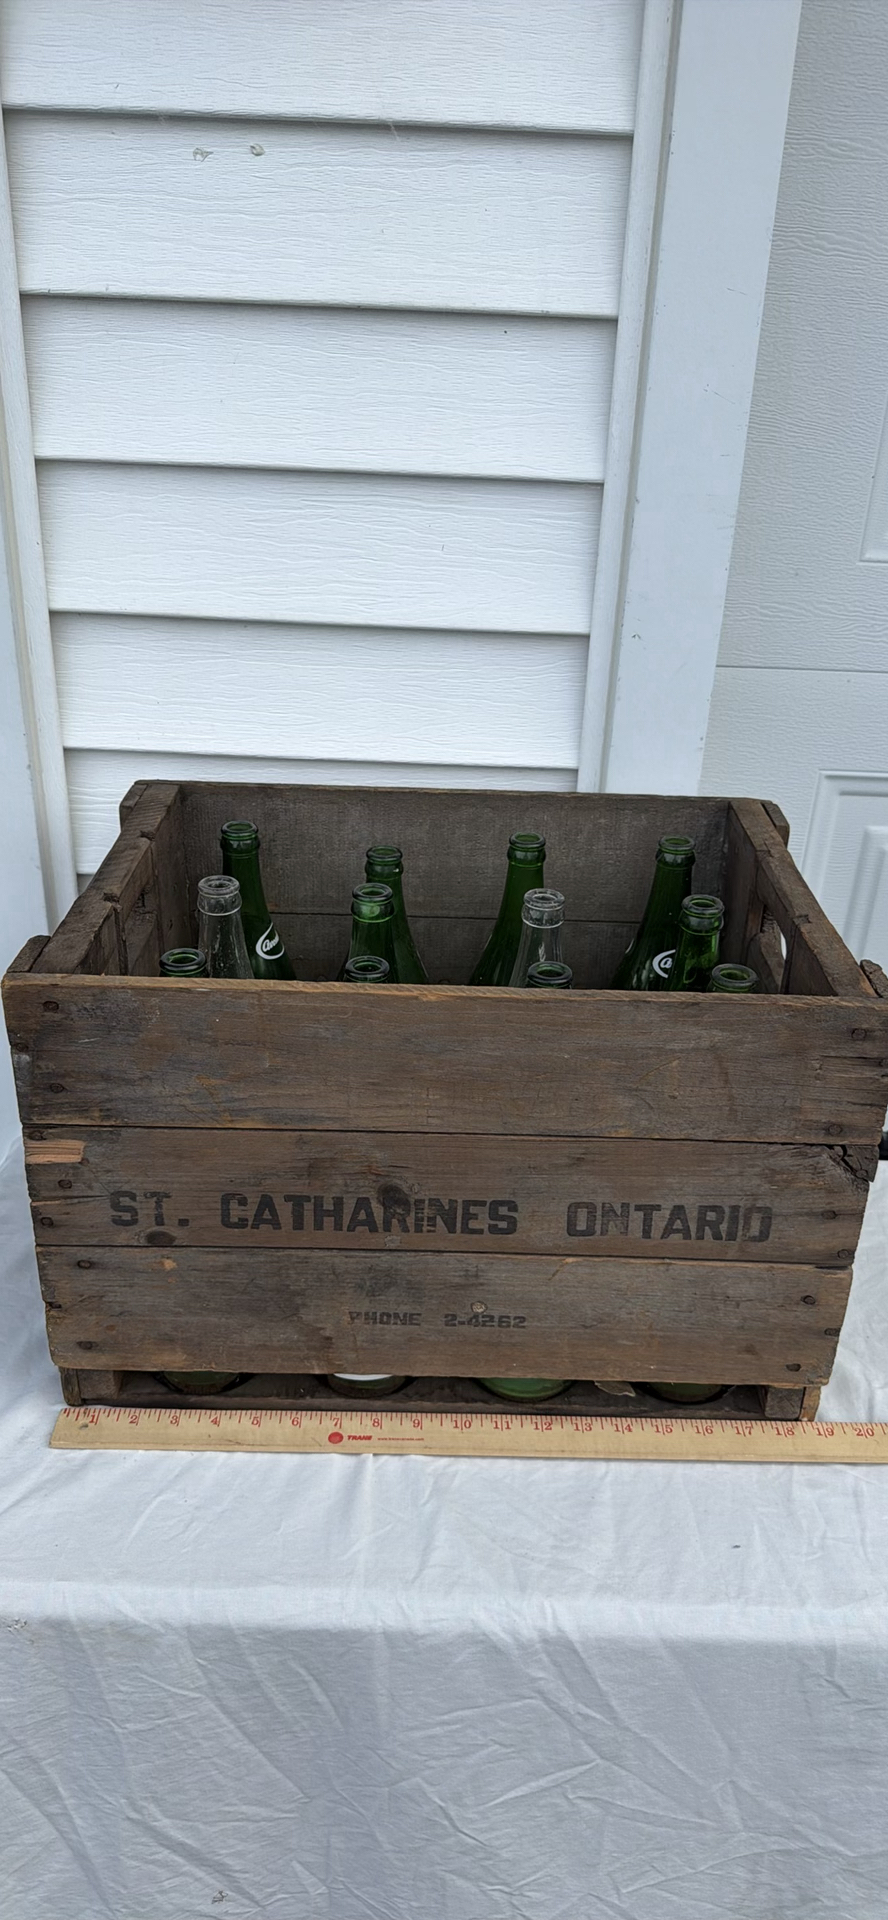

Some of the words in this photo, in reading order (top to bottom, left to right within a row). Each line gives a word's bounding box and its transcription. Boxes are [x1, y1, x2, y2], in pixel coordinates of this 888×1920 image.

[109, 1190, 191, 1227] ST.
[219, 1193, 519, 1236] CATHARINES
[566, 1201, 773, 1243] ONTARIO
[348, 1311, 422, 1327] PHONE
[443, 1313, 527, 1329] 2-4262
[89, 1414, 96, 1424] 1
[129, 1414, 138, 1424] 2
[170, 1414, 179, 1424] 3
[210, 1415, 219, 1425] 4
[251, 1416, 259, 1426] 5
[291, 1417, 300, 1427] 6
[333, 1417, 340, 1427] 7
[372, 1418, 380, 1428] 8
[412, 1418, 420, 1428] 9
[453, 1419, 472, 1429] 10
[493, 1420, 511, 1430] 11
[533, 1421, 552, 1431] 12
[574, 1422, 593, 1431] 13
[614, 1423, 633, 1432] 14
[654, 1424, 673, 1434] 15
[695, 1425, 714, 1435] 16
[735, 1425, 753, 1435] 17
[775, 1426, 795, 1436] 18
[816, 1427, 835, 1437] 19
[854, 1427, 875, 1437] 20
